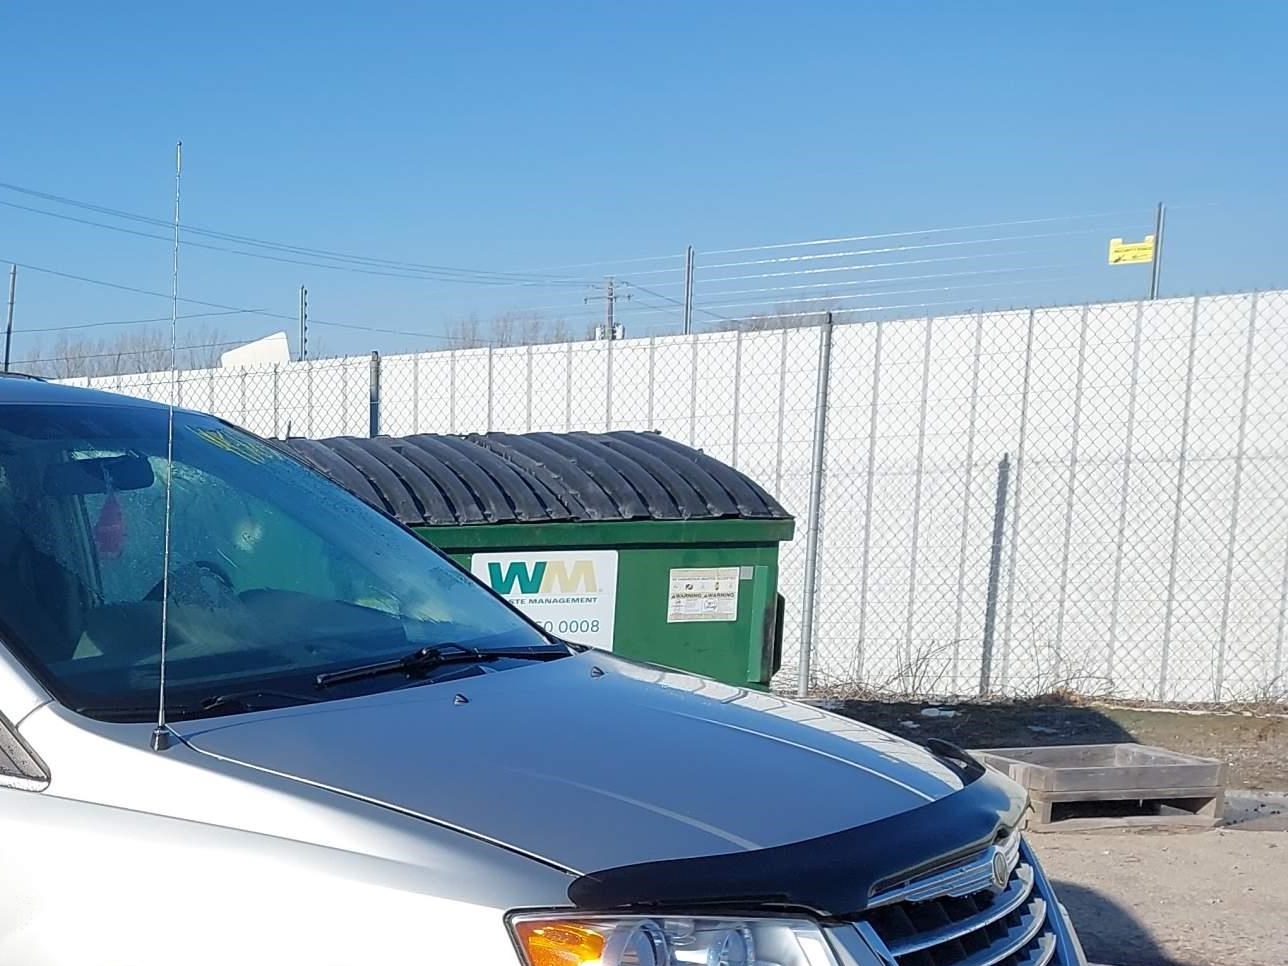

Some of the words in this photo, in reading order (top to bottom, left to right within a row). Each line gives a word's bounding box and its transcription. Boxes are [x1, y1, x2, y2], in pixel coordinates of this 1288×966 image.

[488, 560, 597, 594] WM
[528, 597, 598, 605] MANAGEMENT
[558, 619, 600, 634] 0008
